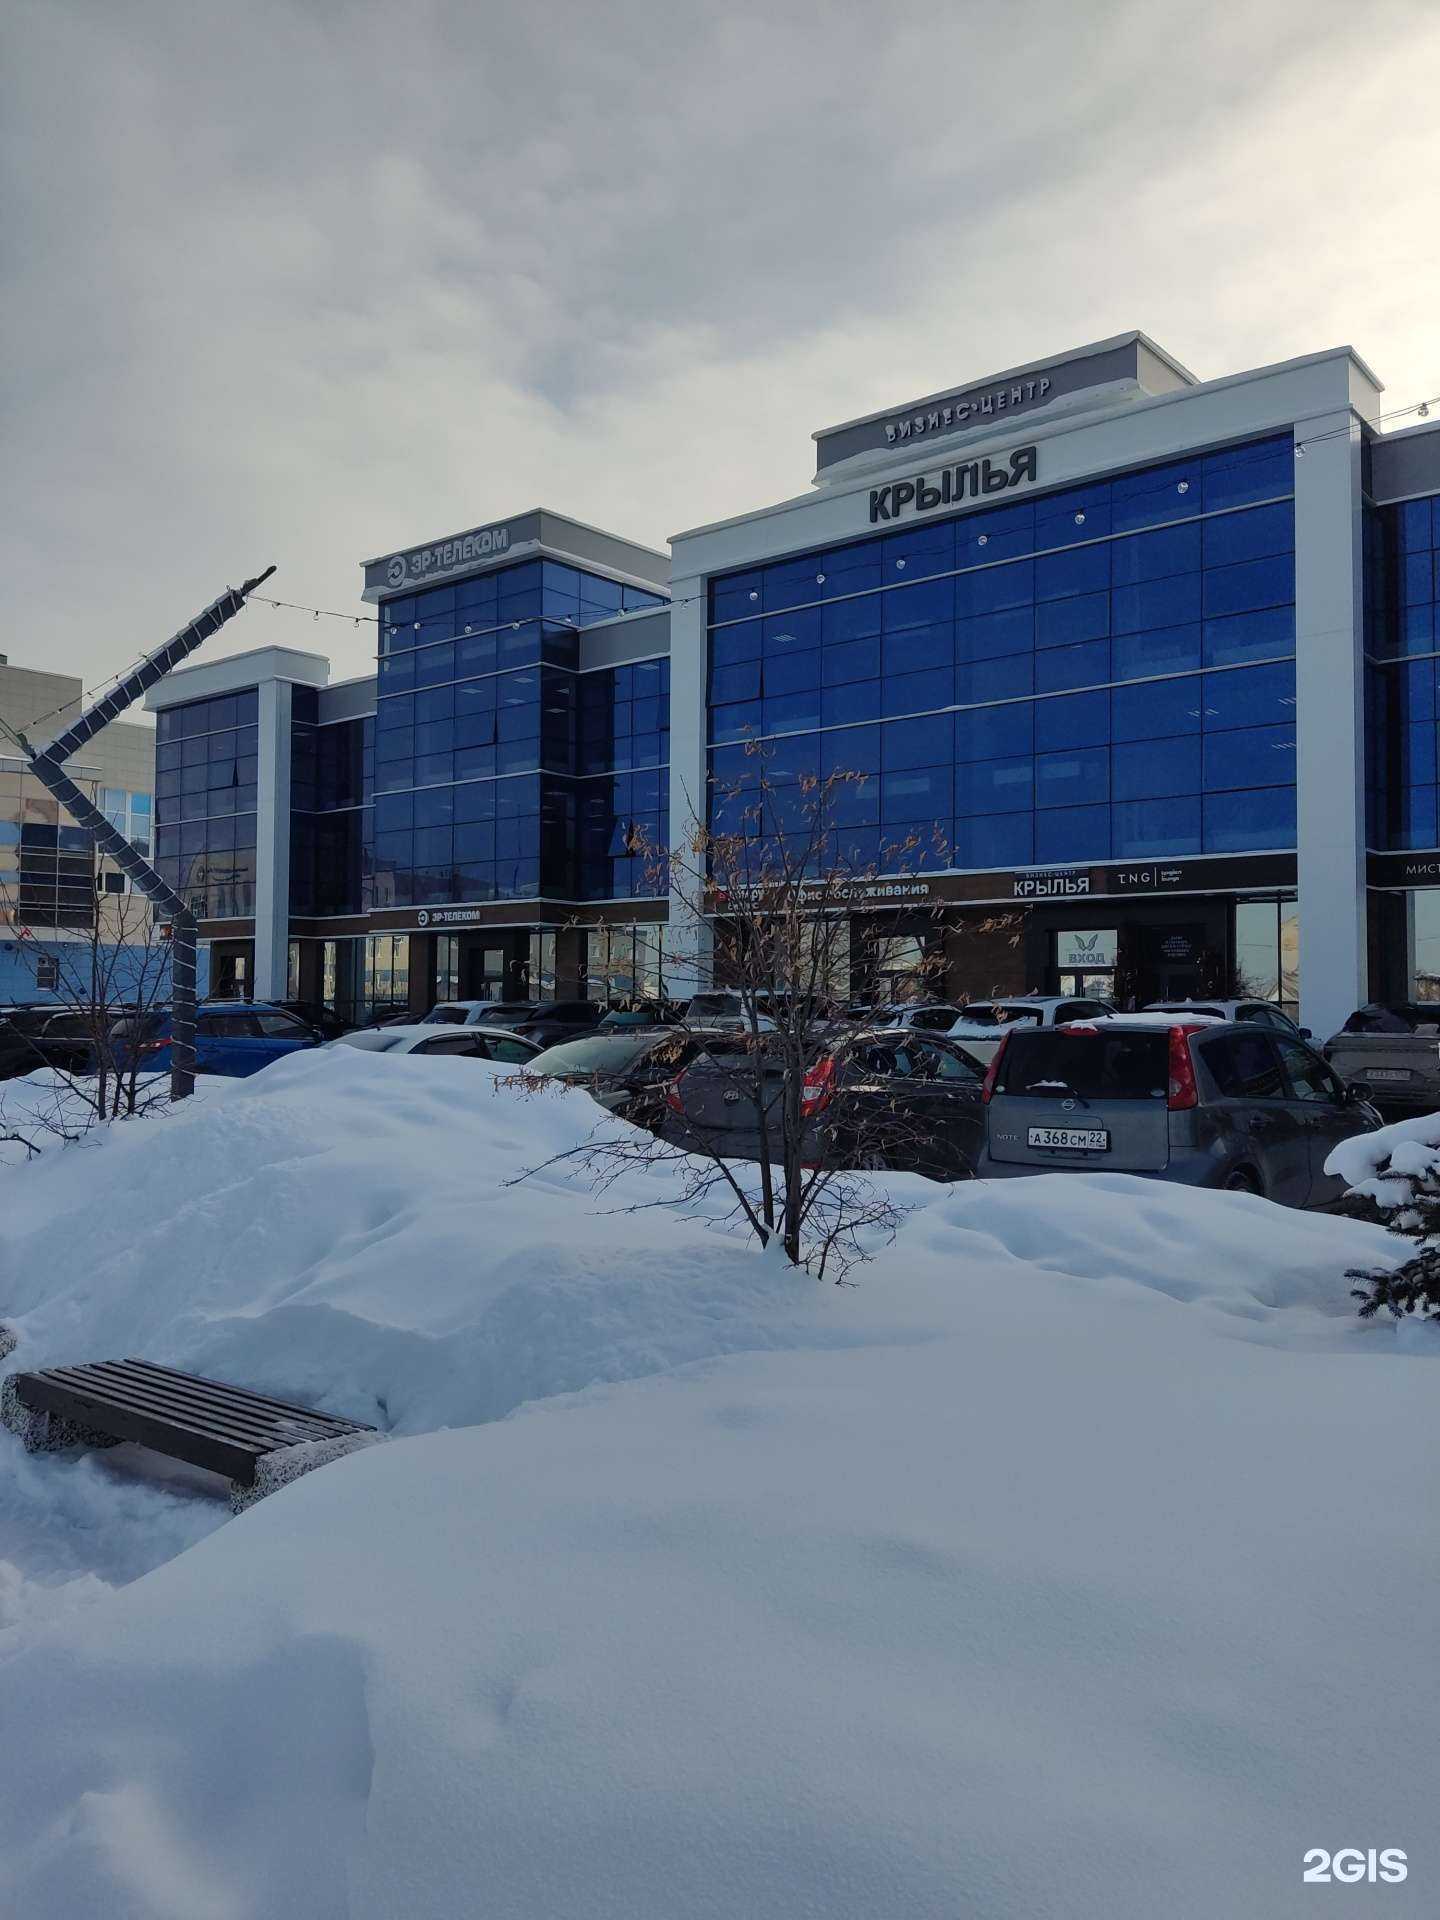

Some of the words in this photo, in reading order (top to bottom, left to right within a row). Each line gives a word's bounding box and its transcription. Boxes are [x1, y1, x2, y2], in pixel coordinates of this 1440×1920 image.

[869, 446, 1037, 523] КРЫЛЬЯ
[411, 528, 510, 573] ЭР-ТЕЛЕКОМ
[1118, 872, 1150, 884] TNG
[1014, 877, 1089, 896] КРЫЛЬЯ
[432, 910, 481, 922] ЭР-ТЕЛЕКОМ
[1069, 952, 1105, 964] ВХОД
